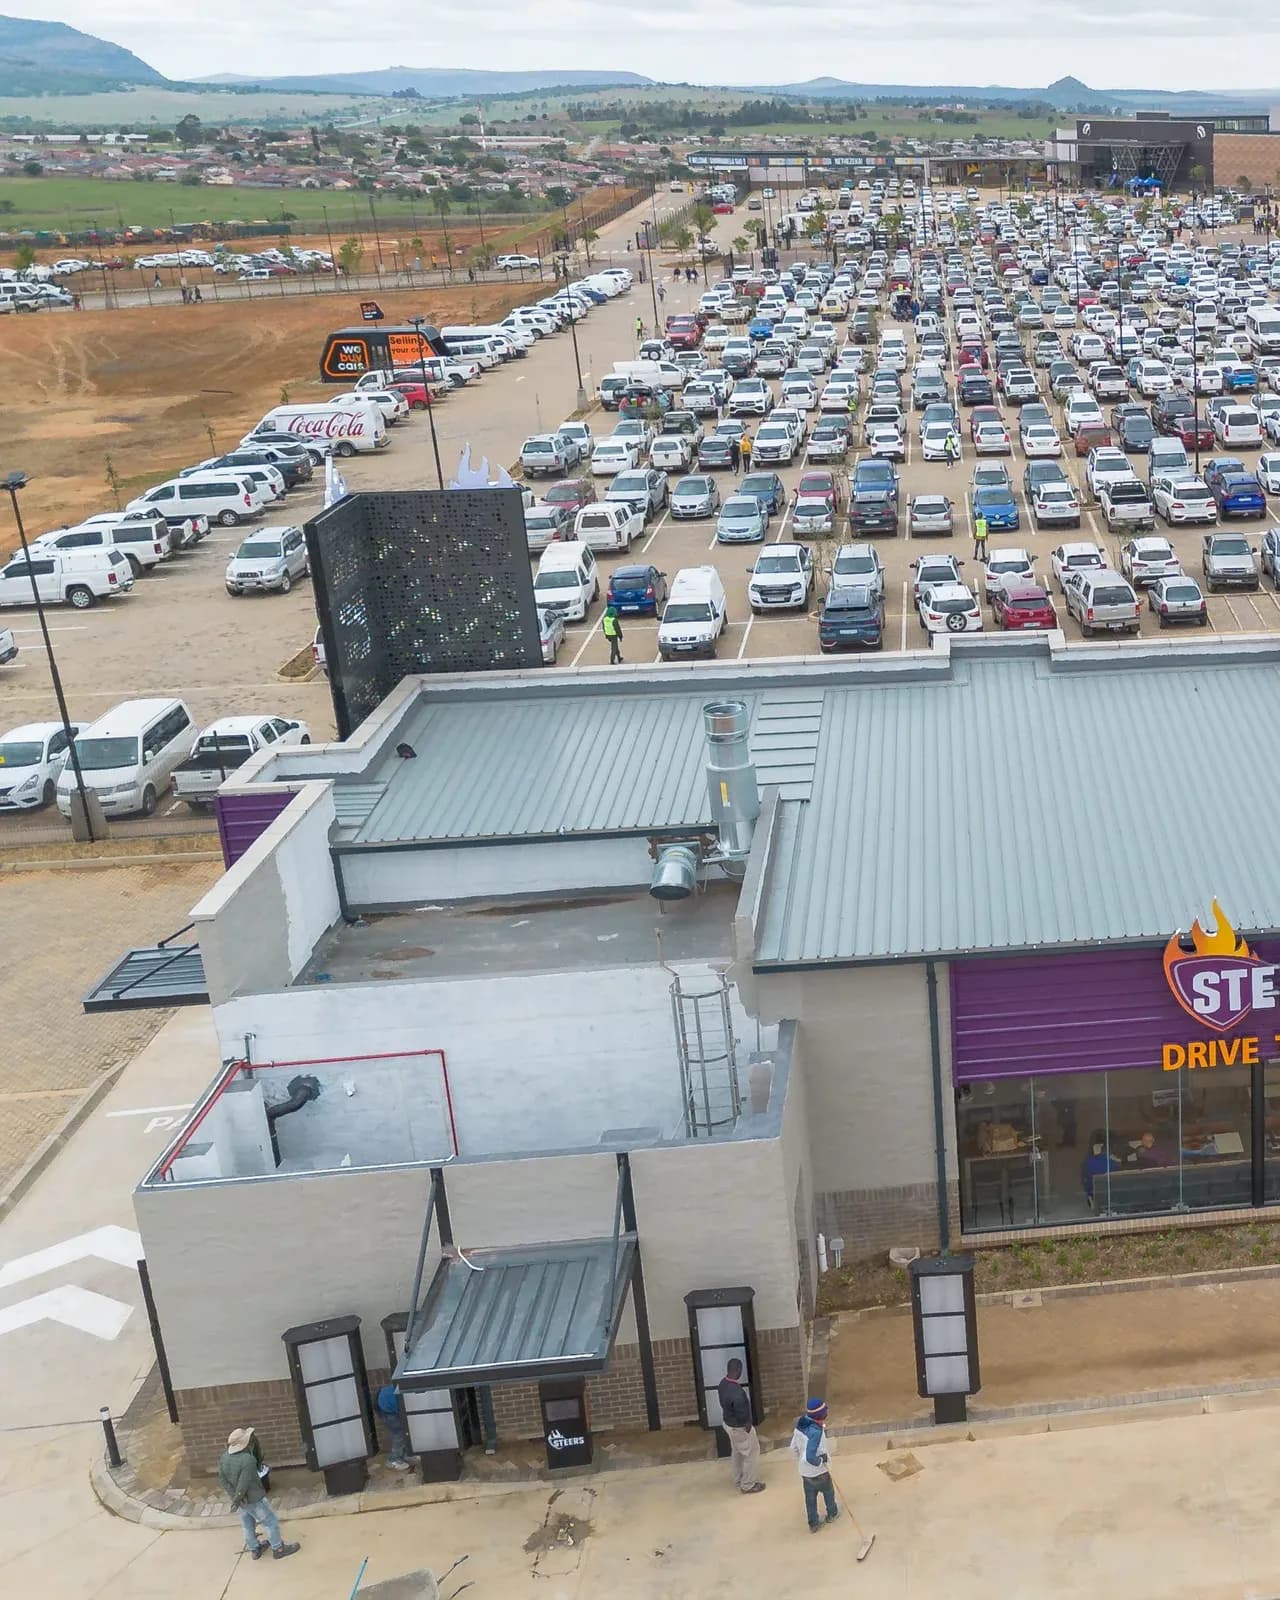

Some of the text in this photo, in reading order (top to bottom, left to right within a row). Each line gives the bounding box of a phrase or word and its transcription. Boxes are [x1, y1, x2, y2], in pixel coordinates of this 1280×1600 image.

[390, 335, 424, 346] Selling
[341, 345, 362, 354] we
[391, 347, 408, 355] your
[340, 353, 362, 363] buy
[338, 361, 364, 371] cars
[288, 411, 366, 438] Coca-Cola
[1162, 1037, 1260, 1071] DRIVE
[553, 1437, 584, 1447] STEERS
